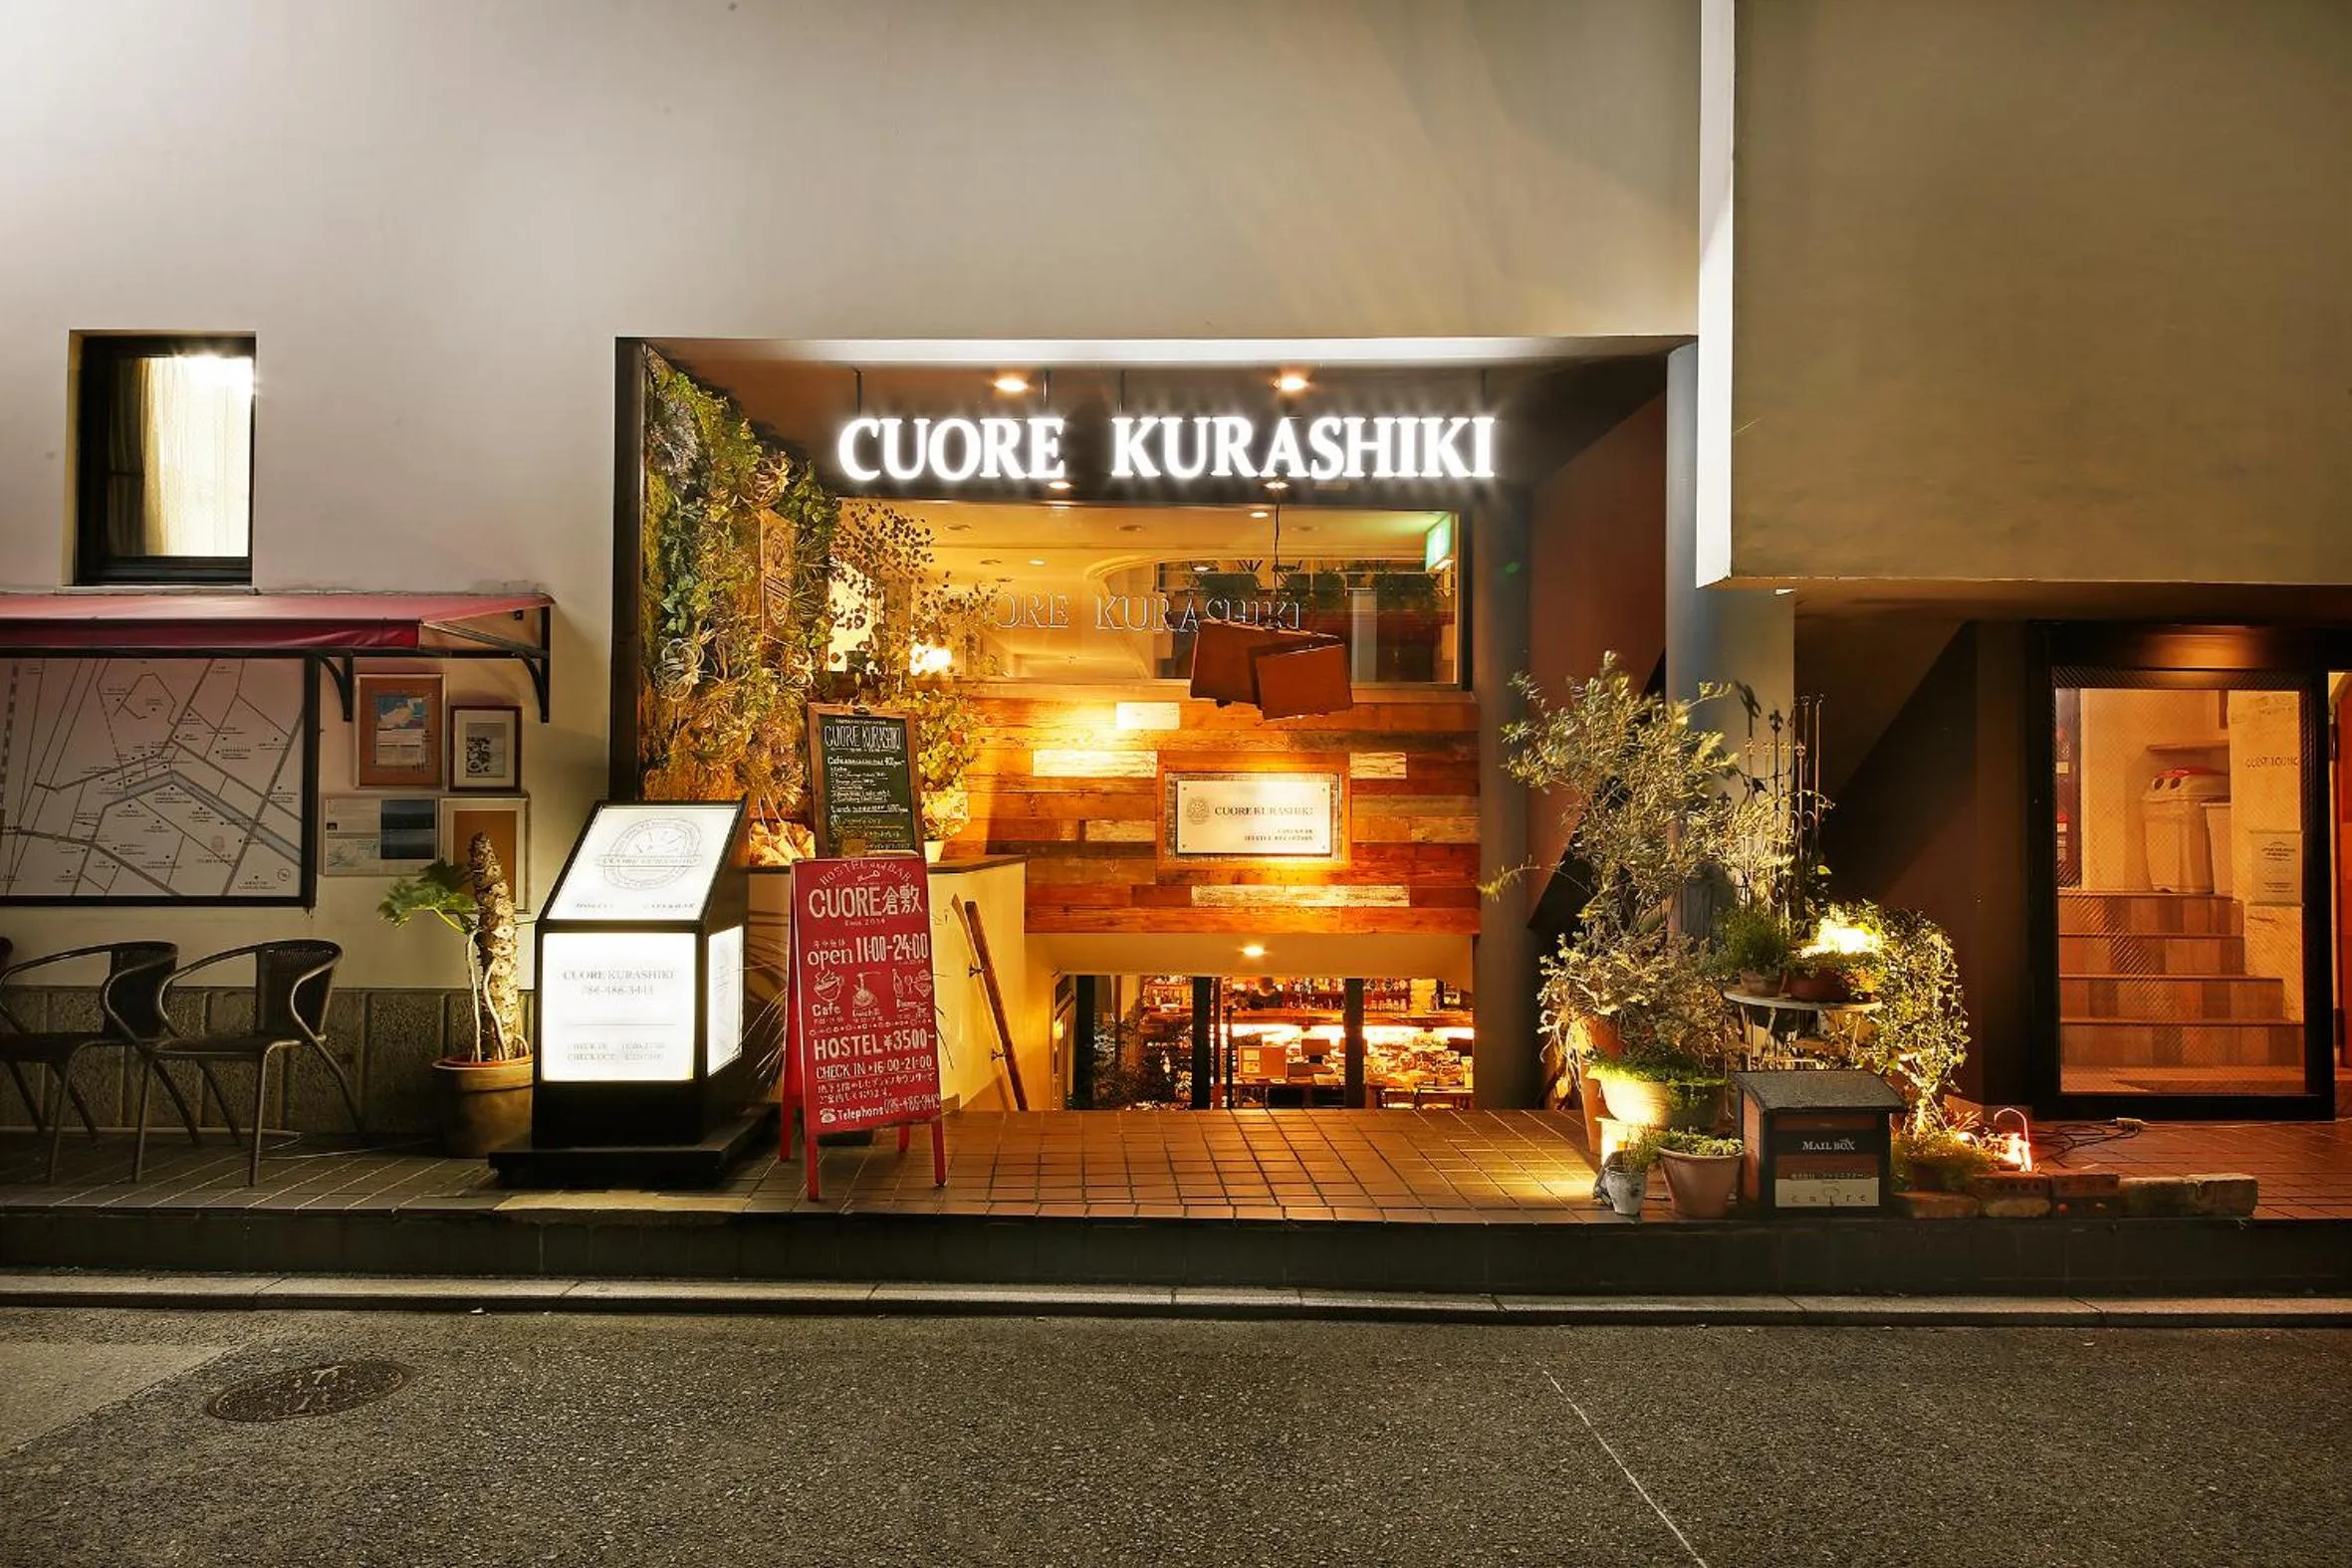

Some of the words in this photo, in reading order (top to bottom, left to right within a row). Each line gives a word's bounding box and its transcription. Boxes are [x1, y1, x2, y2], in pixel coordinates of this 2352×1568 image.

[837, 415, 1065, 483] CUORE
[1110, 415, 1496, 481] KURASHIKI
[823, 725, 859, 748] CUORE
[1214, 805, 1253, 815] CUORE
[819, 862, 868, 885] HOSTEL
[886, 862, 913, 882] BAR
[808, 883, 923, 919] CUORE倉敷
[807, 948, 853, 970] open
[811, 1001, 841, 1016] Cafe
[814, 1034, 883, 1060] HOSTEL
[816, 1062, 849, 1079] CHECK
[853, 1062, 866, 1075] IN
[837, 1106, 883, 1123] Telephone
